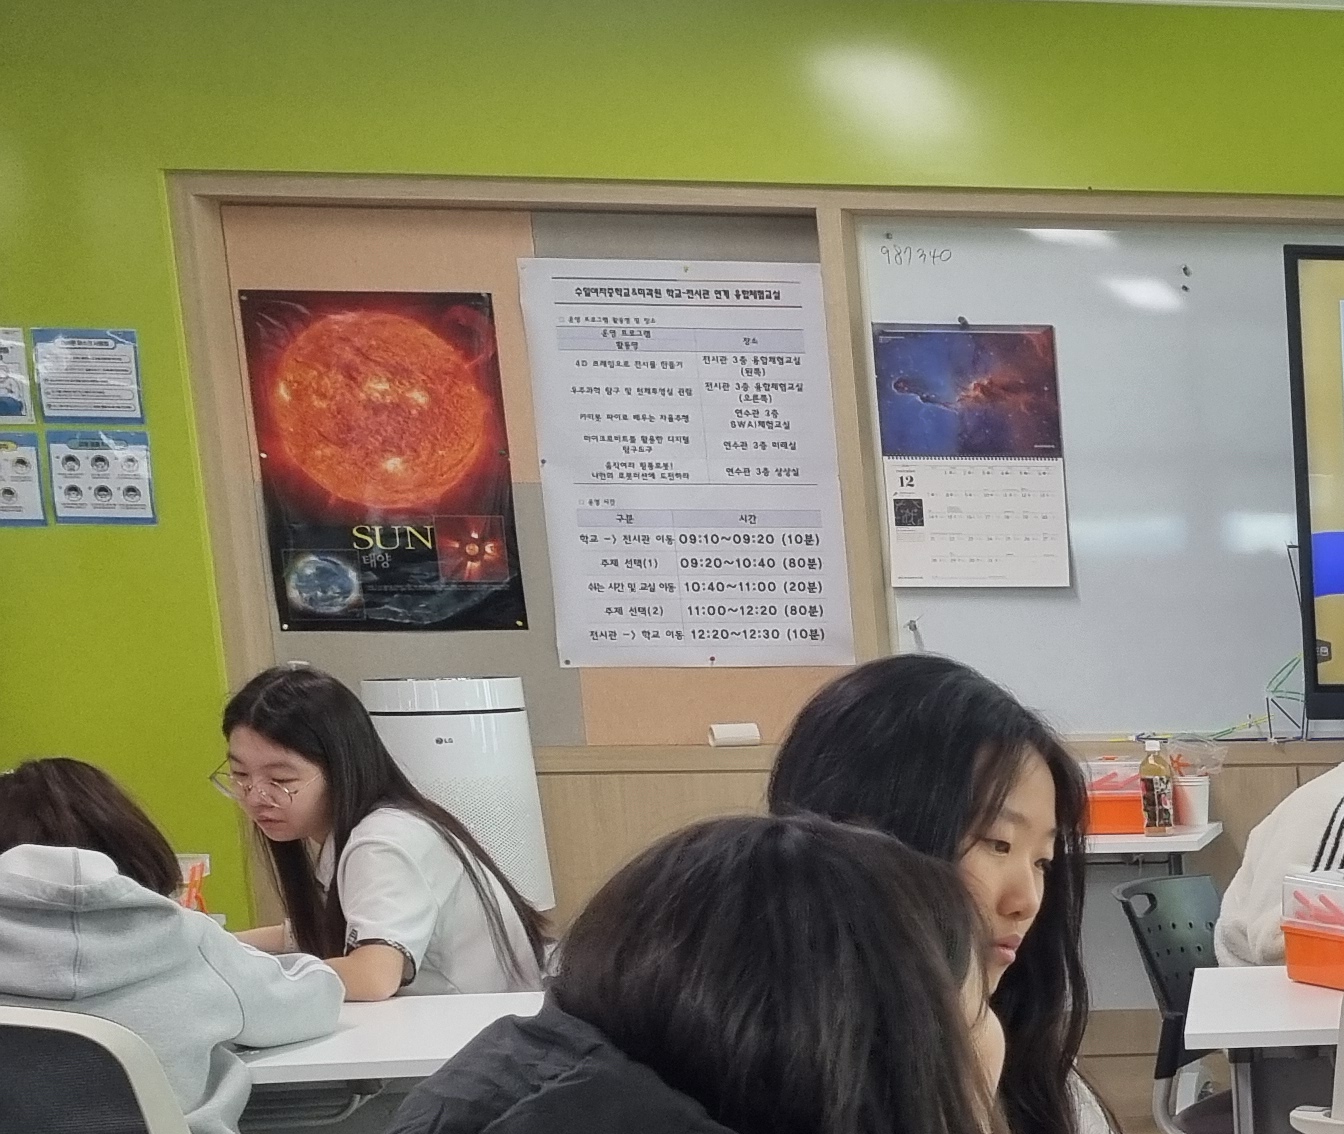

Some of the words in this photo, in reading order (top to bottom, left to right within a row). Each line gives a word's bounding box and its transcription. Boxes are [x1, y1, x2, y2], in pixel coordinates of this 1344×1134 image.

[703, 356, 728, 364] 전시관
[733, 356, 747, 365] 3층
[752, 356, 800, 365] 융합체험교실
[705, 382, 730, 391] 전시관
[735, 383, 750, 392] 3층
[755, 383, 803, 392] 융합체험교실
[735, 409, 759, 418] 연수관
[765, 409, 779, 419] 3층
[723, 441, 747, 450] 연수관
[753, 441, 767, 450] 3층
[726, 468, 750, 476] 연수관
[756, 467, 770, 477] 3층
[900, 476, 914, 487] 12
[616, 514, 634, 524] 구분
[739, 515, 756, 524] 시간
[352, 525, 434, 550] SUN
[580, 534, 598, 544] 학교
[623, 535, 650, 544] 전시관
[656, 534, 675, 545] 이동
[679, 534, 774, 544] 09:10~09:20
[782, 534, 819, 546] (10분)
[362, 553, 392, 568] 태양
[601, 559, 618, 567] 주제
[625, 559, 658, 569] 선택(1)
[681, 558, 775, 568] 09:20~10:40
[783, 558, 822, 570] (80분)
[588, 583, 605, 592] 쉬는
[608, 583, 624, 592] 시간
[628, 583, 636, 592] 및
[639, 583, 655, 592] 교실
[659, 583, 676, 593] 이동
[685, 582, 776, 592] 10:40~11:00
[784, 581, 822, 593] (20분)
[605, 607, 623, 615] 주제
[629, 606, 663, 616] 선택(2)
[688, 605, 777, 615] 11:00~12:20
[785, 605, 823, 617] (80분)
[590, 631, 617, 640] 전시관
[642, 630, 660, 640] 학교
[666, 630, 684, 640] 이동
[691, 629, 779, 639] 12:20~12:30
[787, 628, 824, 641] (10분)
